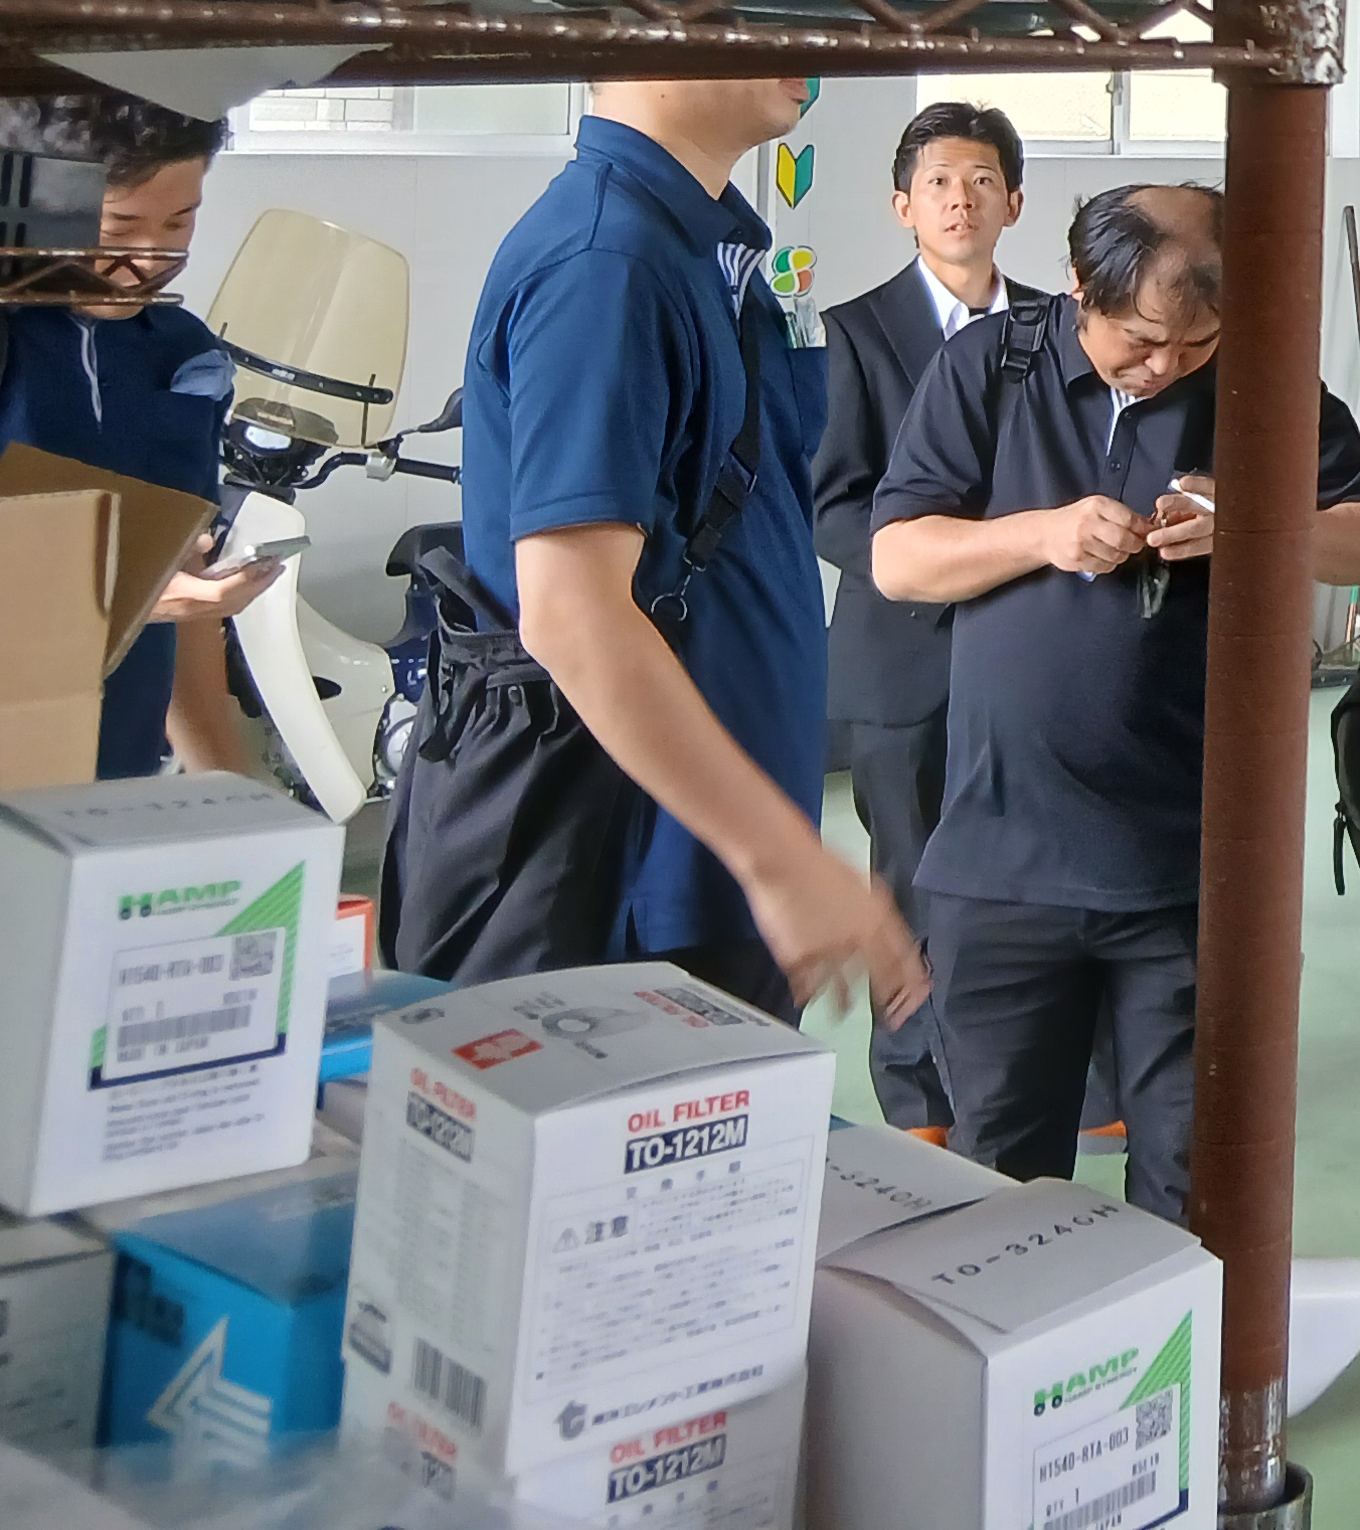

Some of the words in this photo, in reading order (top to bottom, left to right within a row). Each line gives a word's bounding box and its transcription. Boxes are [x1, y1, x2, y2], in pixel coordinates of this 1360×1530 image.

[118, 880, 243, 921] HAMP
[627, 1107, 666, 1134] OIL
[672, 1089, 751, 1124] FILTER
[627, 1117, 746, 1168] TO-1212M
[1033, 1347, 1139, 1417] HAMP
[610, 1439, 645, 1465] OIL
[654, 1410, 728, 1448] FILTER
[611, 1440, 723, 1499] TO-1212M
